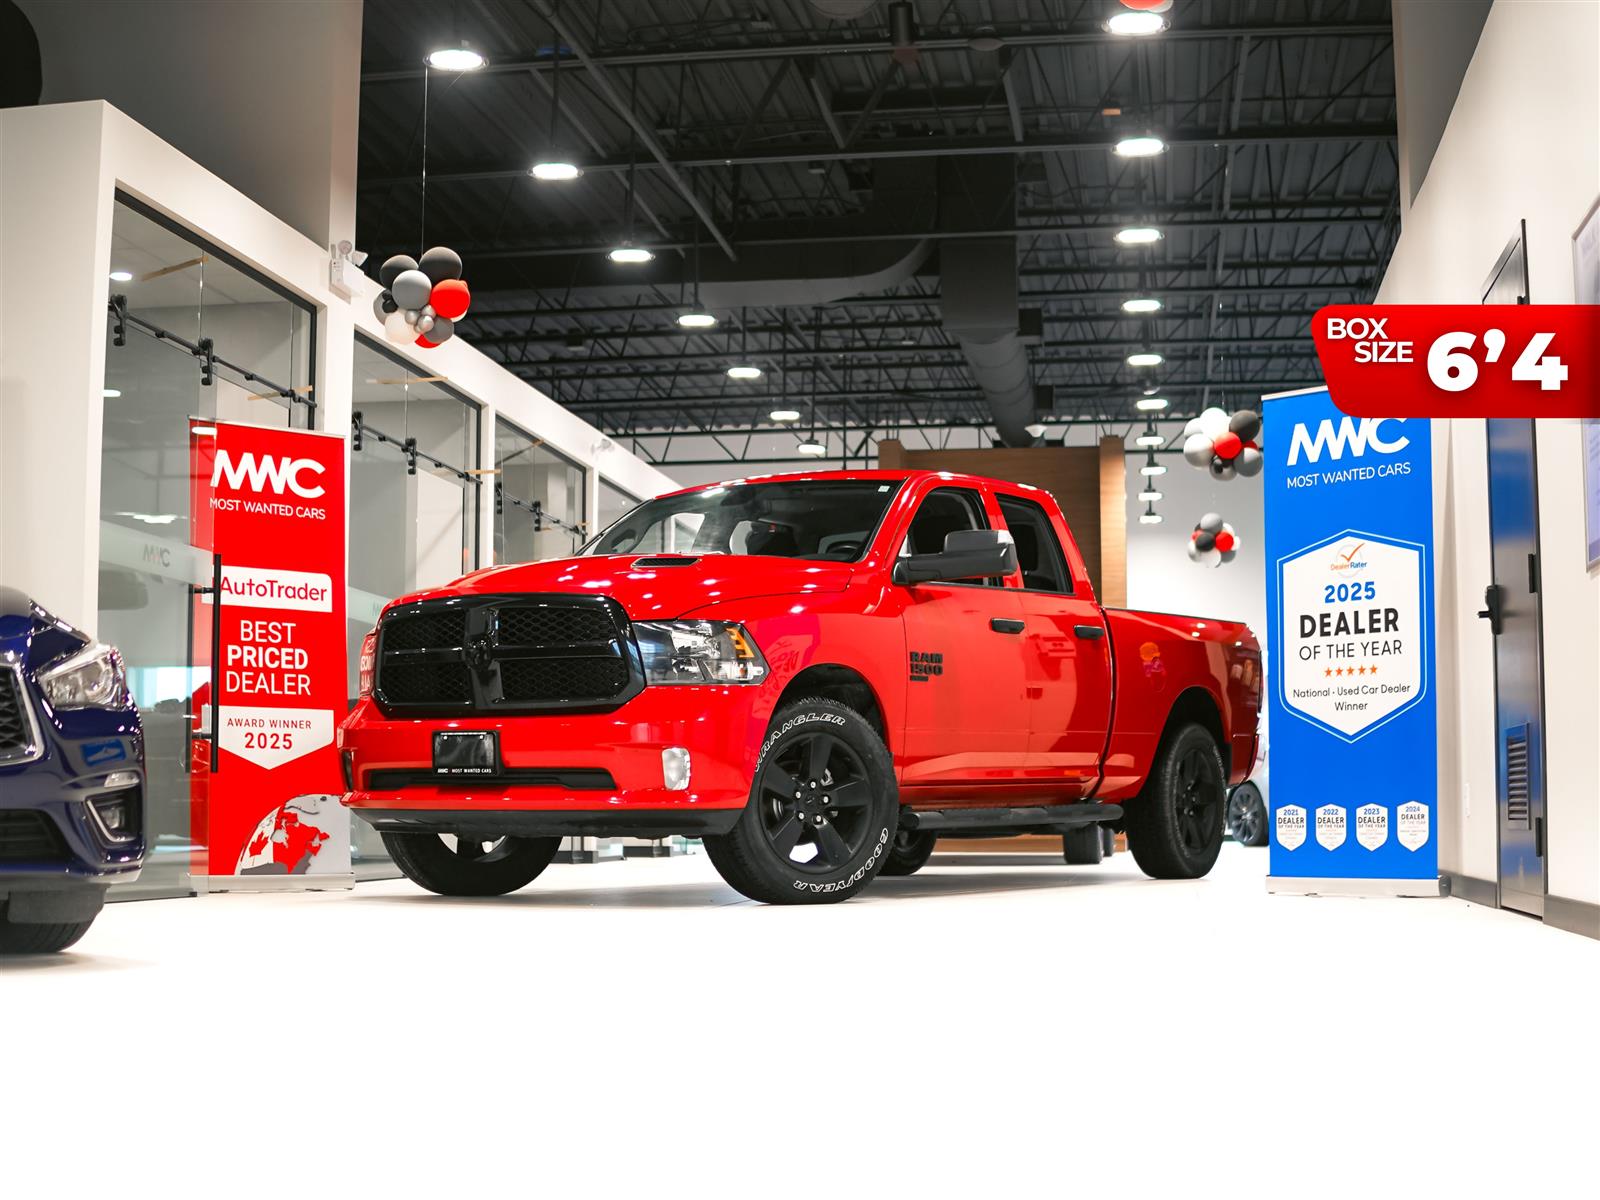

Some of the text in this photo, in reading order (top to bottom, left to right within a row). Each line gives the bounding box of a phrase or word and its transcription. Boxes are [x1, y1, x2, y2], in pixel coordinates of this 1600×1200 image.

[1286, 415, 1410, 467] MWC
[209, 449, 326, 499] MWC
[1286, 462, 1411, 489] MOST WANTED CARS
[209, 497, 326, 520] MOST WANTED CARS
[220, 576, 327, 601] AutoTrader
[1324, 581, 1376, 604] 2025
[240, 619, 296, 644] BEST
[1300, 608, 1399, 639] DEALER
[227, 644, 308, 670] PRICED
[909, 651, 943, 664] RAM
[1299, 639, 1403, 661] OF THE YEAR
[909, 663, 943, 676] 1500
[226, 670, 312, 696] DEALER
[1293, 683, 1411, 698] National Used Car Dealer
[1334, 701, 1369, 711] Winner
[226, 718, 312, 729] AWARD WINNER
[244, 732, 293, 749] 2025
[754, 712, 846, 773] WRANGLER
[1283, 808, 1299, 816] 2021
[1317, 816, 1344, 824] DEALER
[1323, 808, 1339, 816] 2022
[793, 828, 889, 893] GOODYEAR
